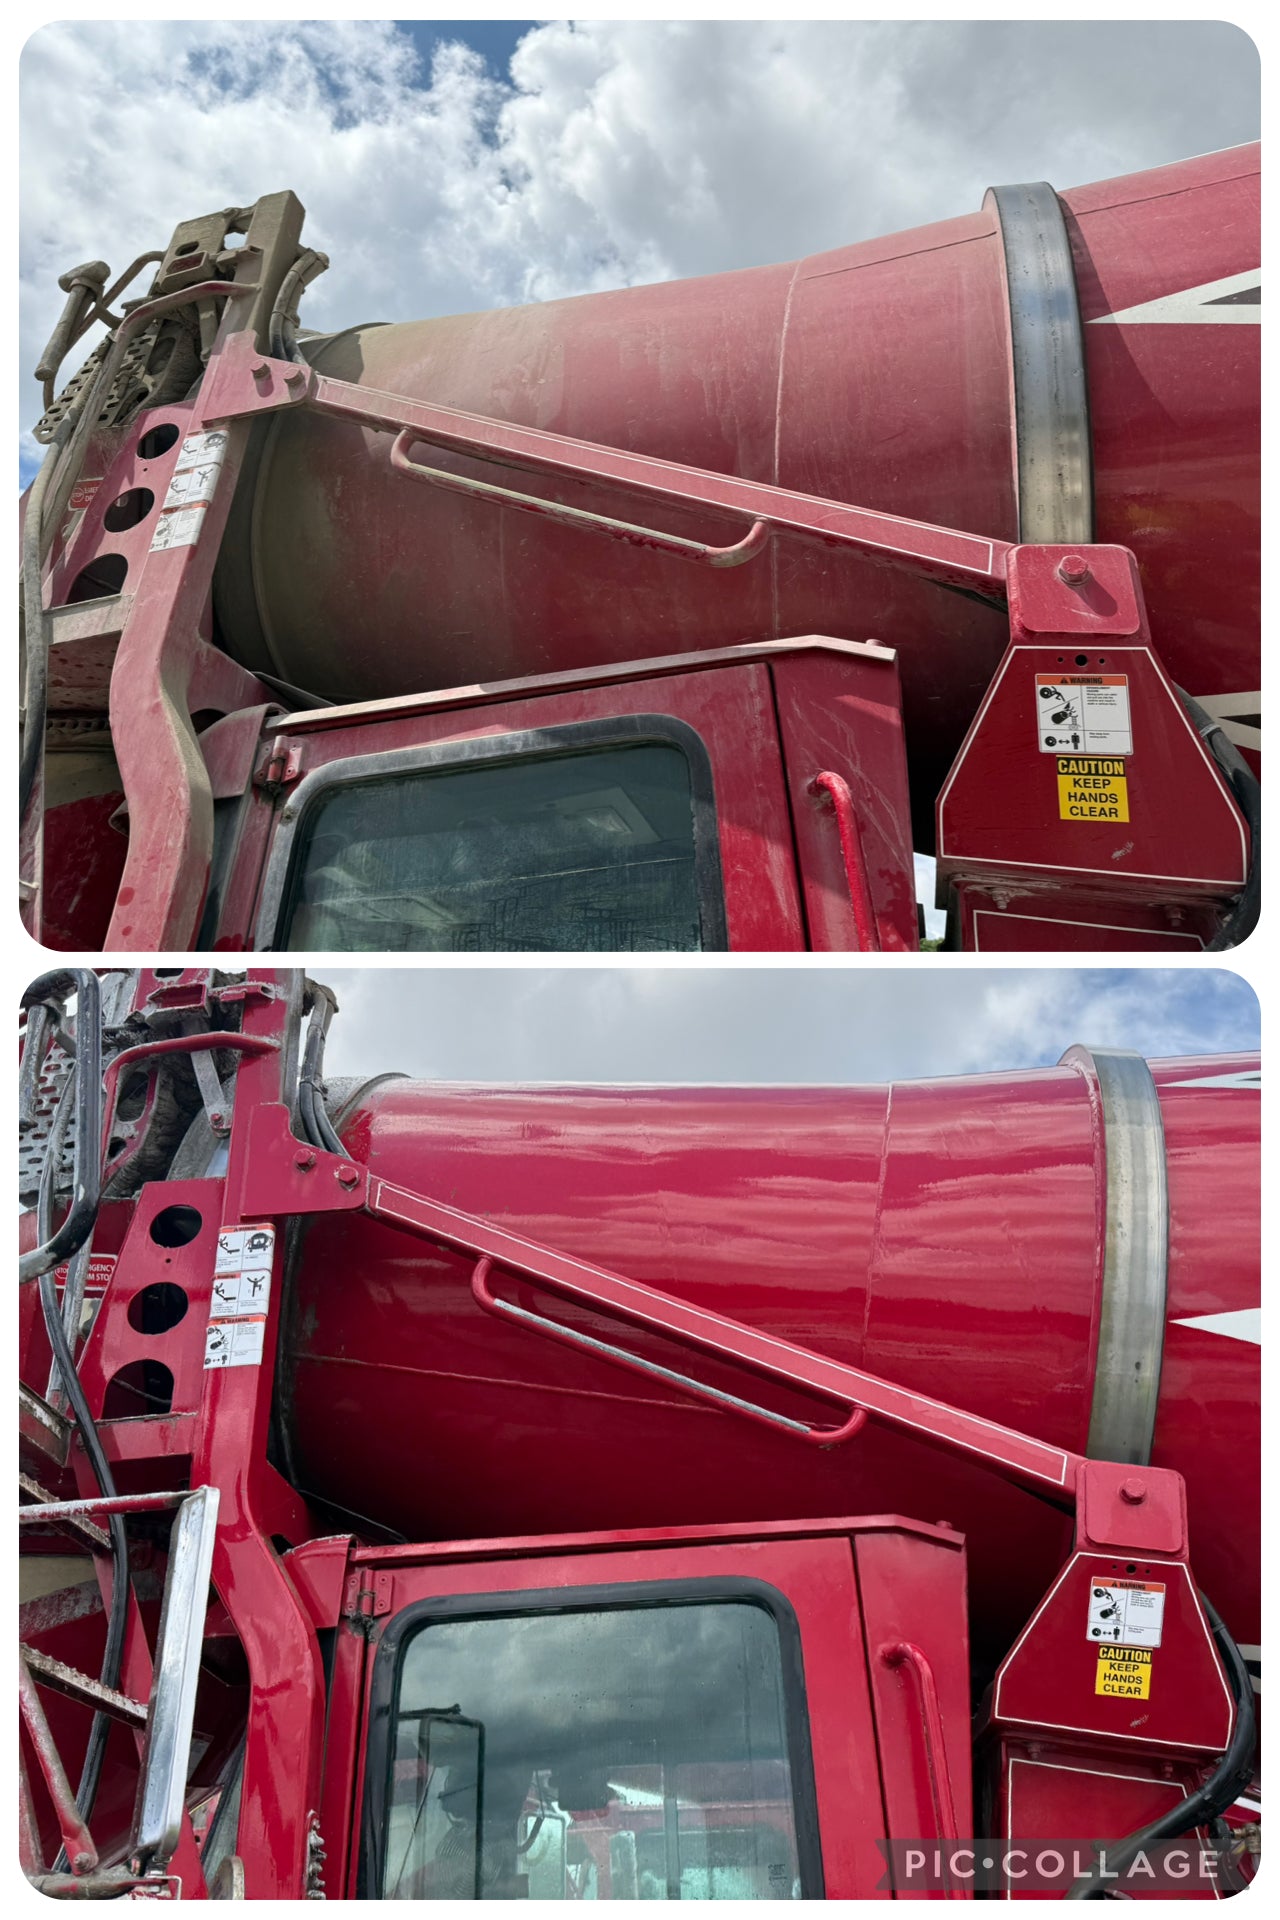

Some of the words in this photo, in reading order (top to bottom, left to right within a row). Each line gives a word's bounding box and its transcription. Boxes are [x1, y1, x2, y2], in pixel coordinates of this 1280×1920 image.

[1070, 677, 1103, 685] WARNING
[1057, 759, 1124, 775] CAUTION
[1073, 777, 1111, 789] KEEP
[1067, 792, 1119, 804] HANDS
[1069, 805, 1119, 818] CLEAR
[96, 1273, 111, 1282] STO
[1119, 1581, 1146, 1590] WARNING
[1099, 1646, 1152, 1663] CAUTION
[1109, 1661, 1140, 1673] KEEP
[1103, 1673, 1143, 1685] HANDS
[1103, 1684, 1142, 1695] CLEAR
